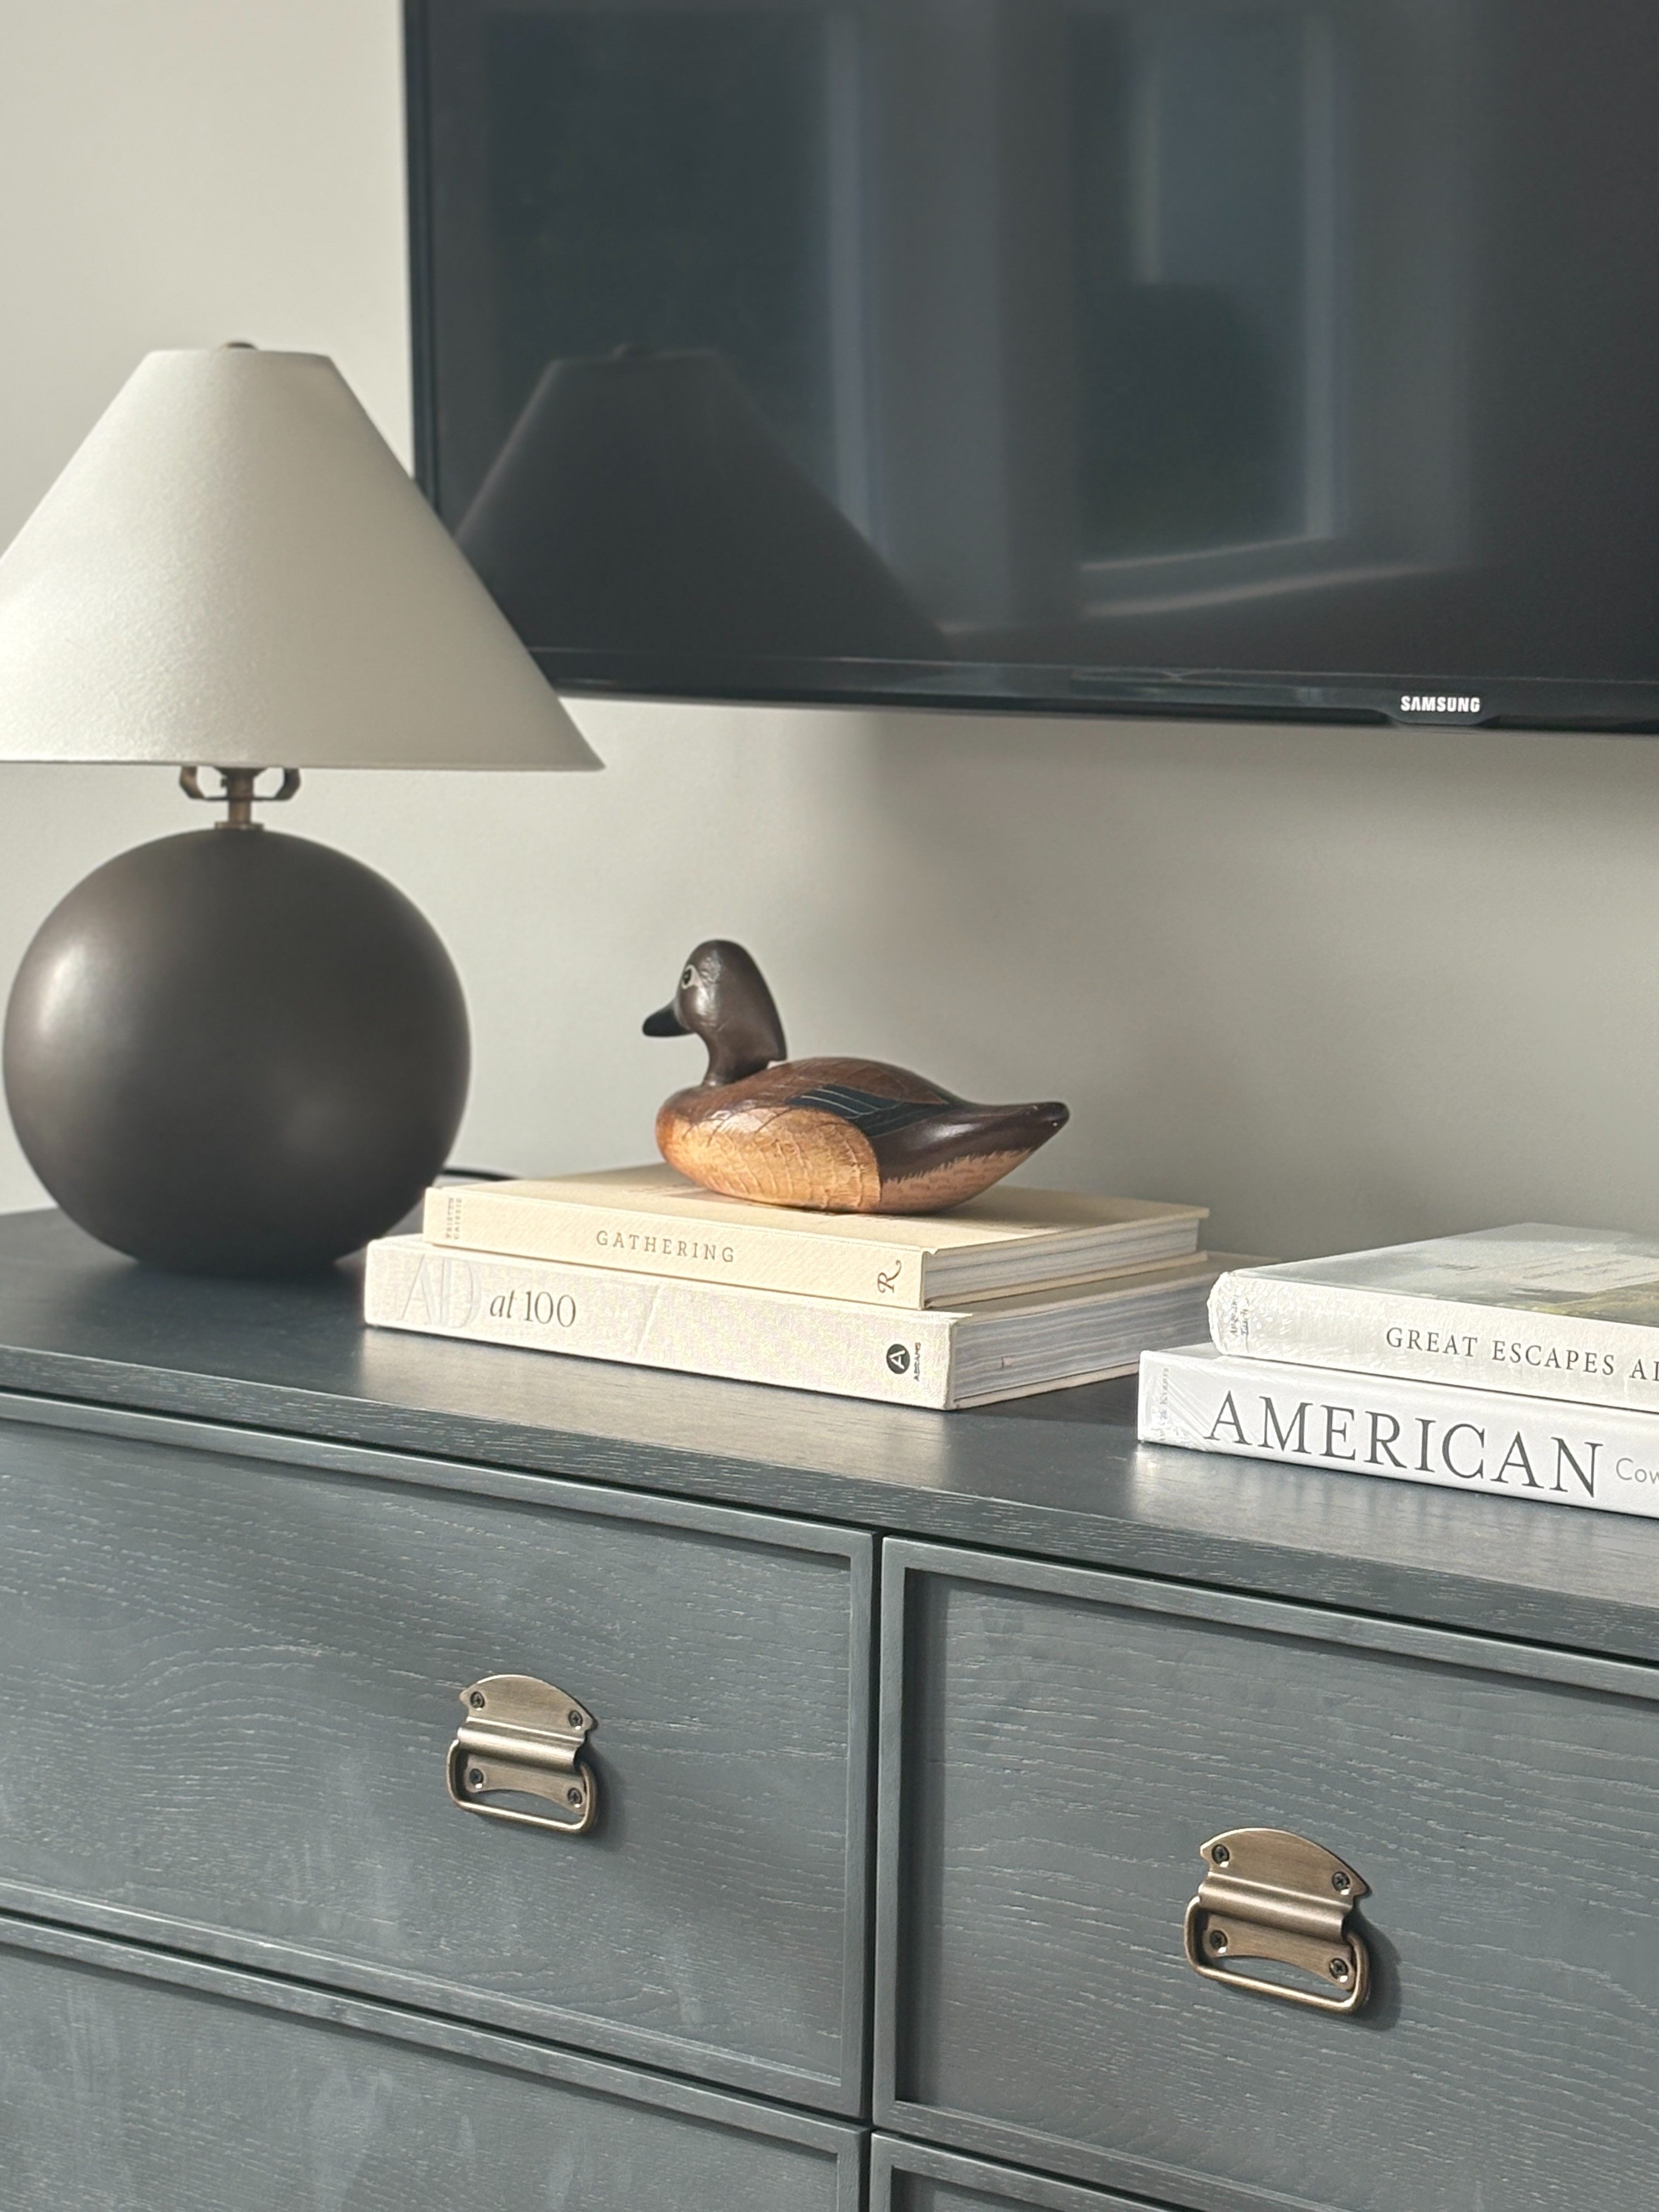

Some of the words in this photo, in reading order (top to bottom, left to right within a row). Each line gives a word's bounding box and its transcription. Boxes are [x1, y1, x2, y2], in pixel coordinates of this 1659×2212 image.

[1401, 696, 1480, 712] SAMSUNG
[596, 1230, 734, 1262] GATHERING
[877, 1260, 902, 1294] R
[490, 1290, 517, 1319] at
[524, 1291, 577, 1328] 100
[1386, 1327, 1478, 1357] GREAT
[1491, 1340, 1615, 1375] ESCAPES
[1203, 1390, 1604, 1498] AMERICAN
